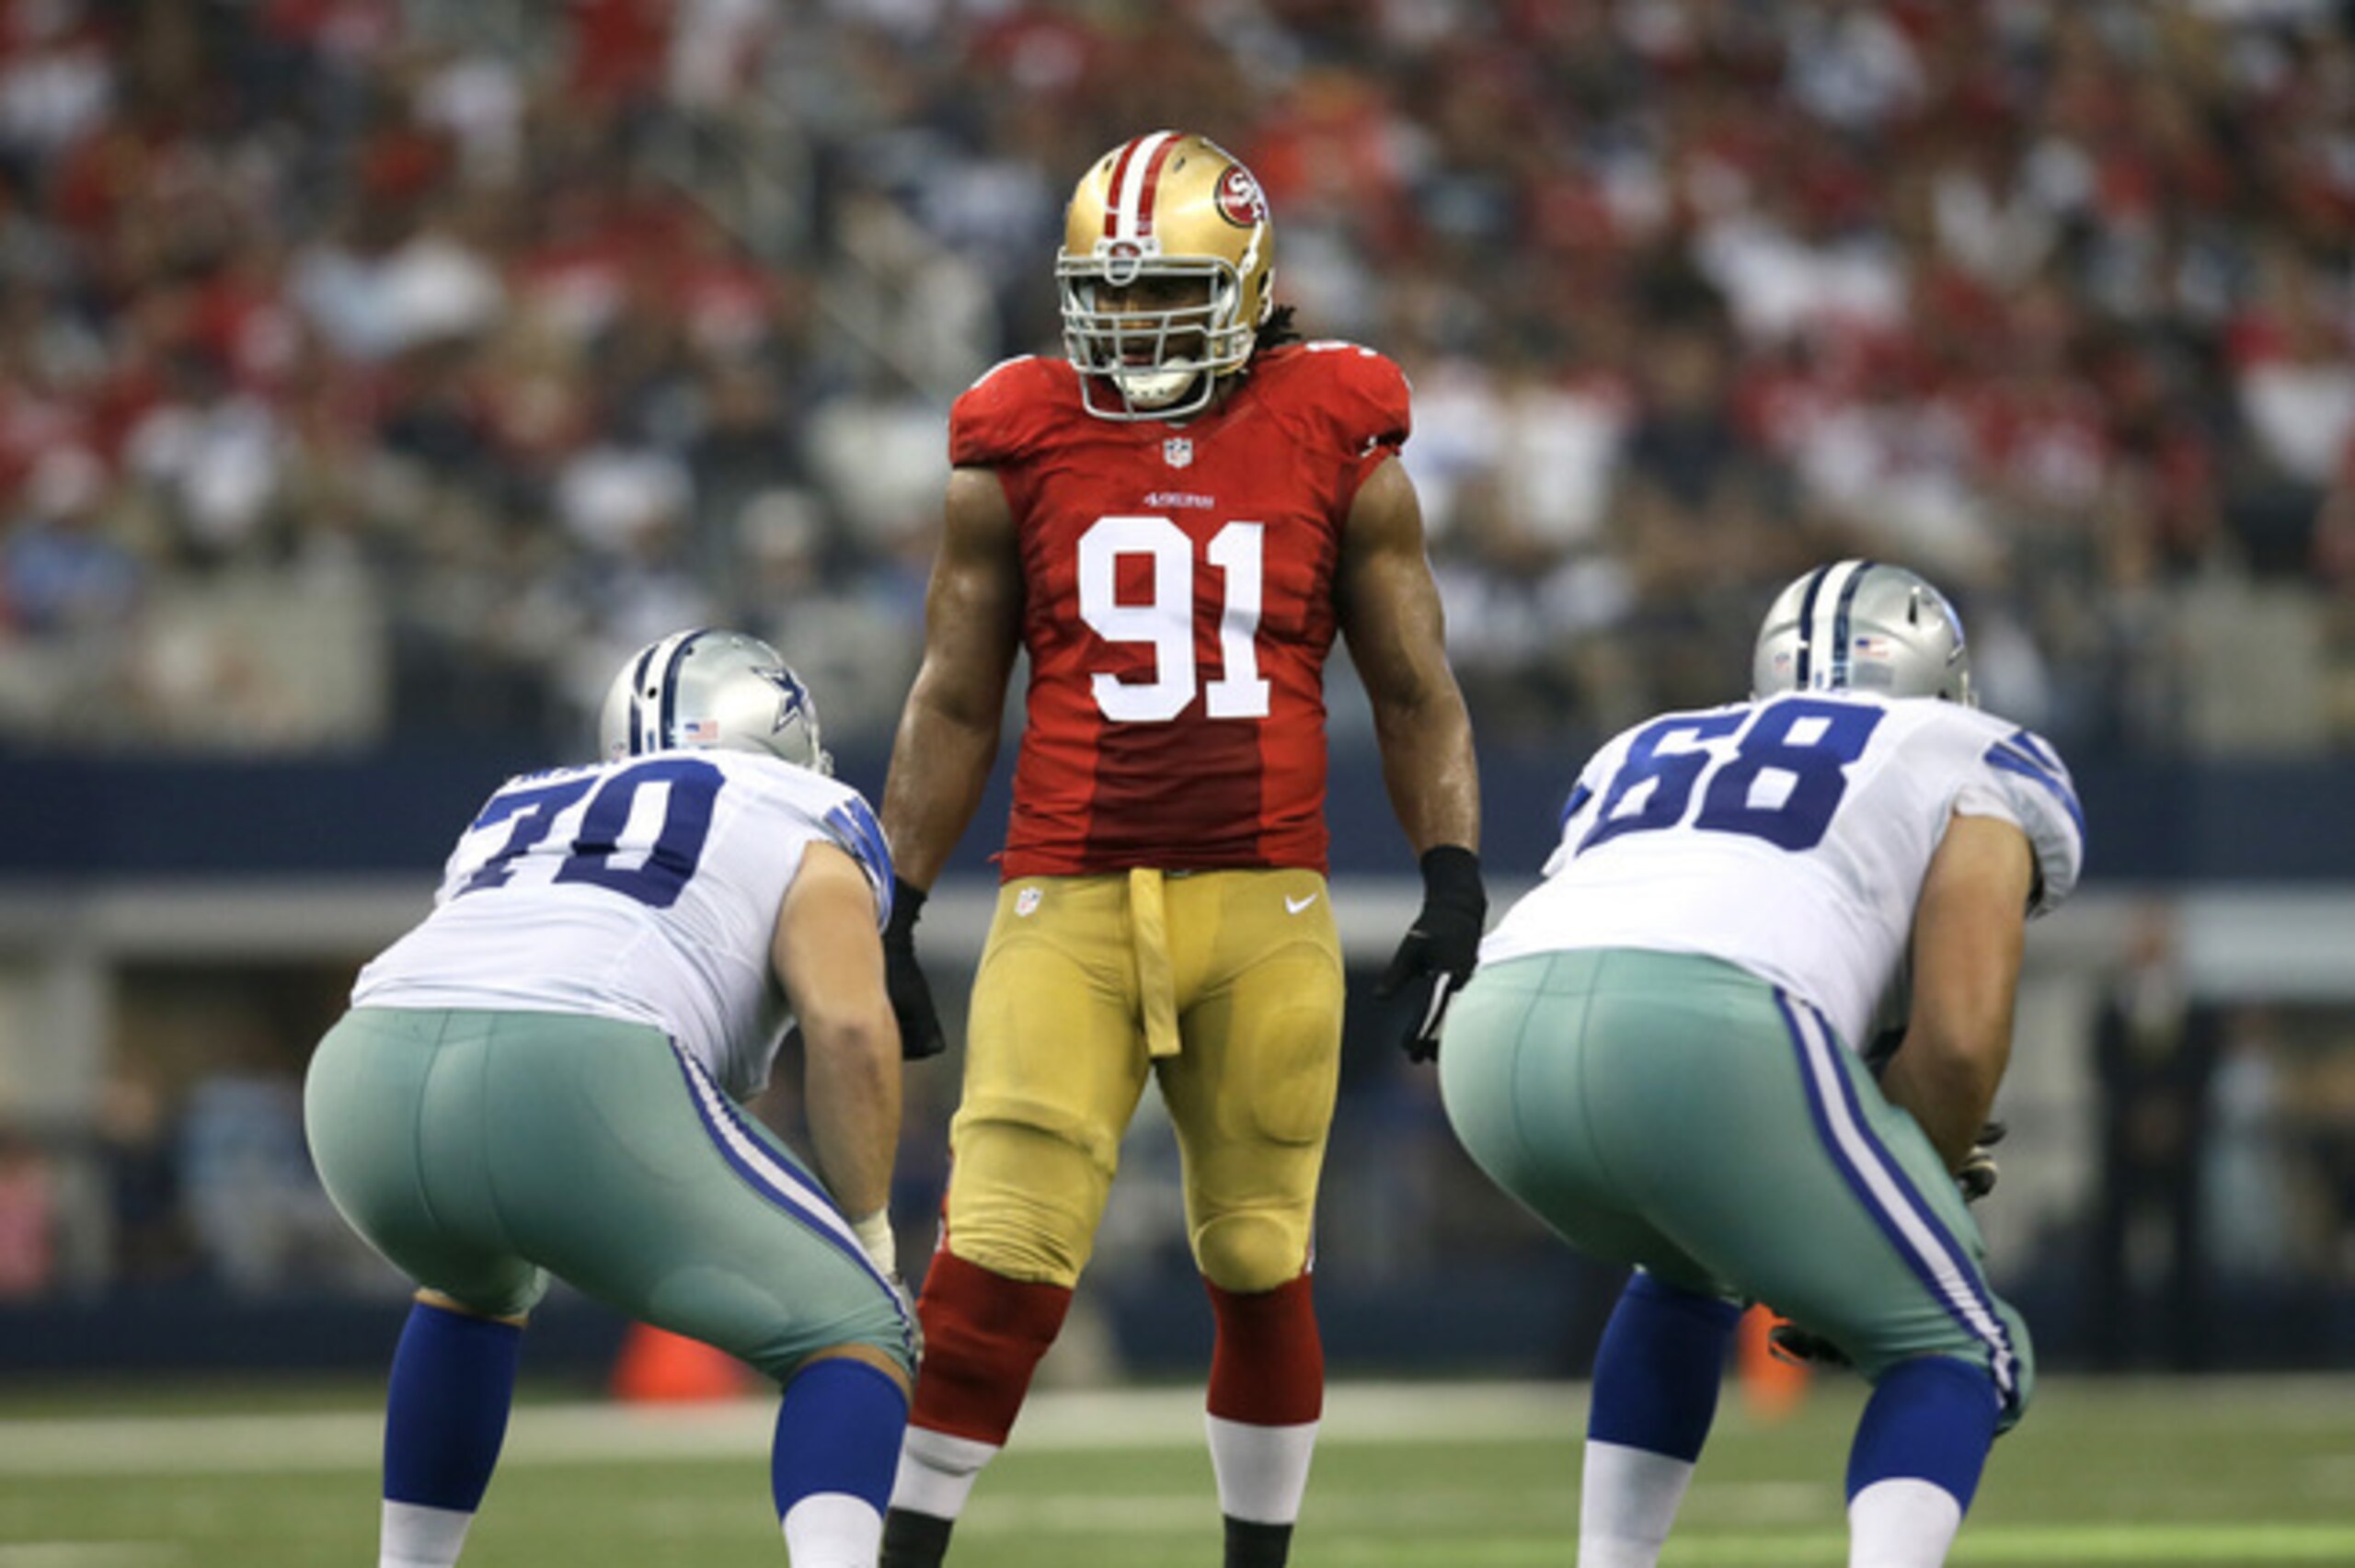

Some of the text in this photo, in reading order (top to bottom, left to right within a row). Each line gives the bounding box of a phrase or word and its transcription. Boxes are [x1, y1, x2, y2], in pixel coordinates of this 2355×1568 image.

[1077, 516, 1270, 721] 91
[454, 758, 726, 909] 70
[1574, 697, 1888, 853] 68
